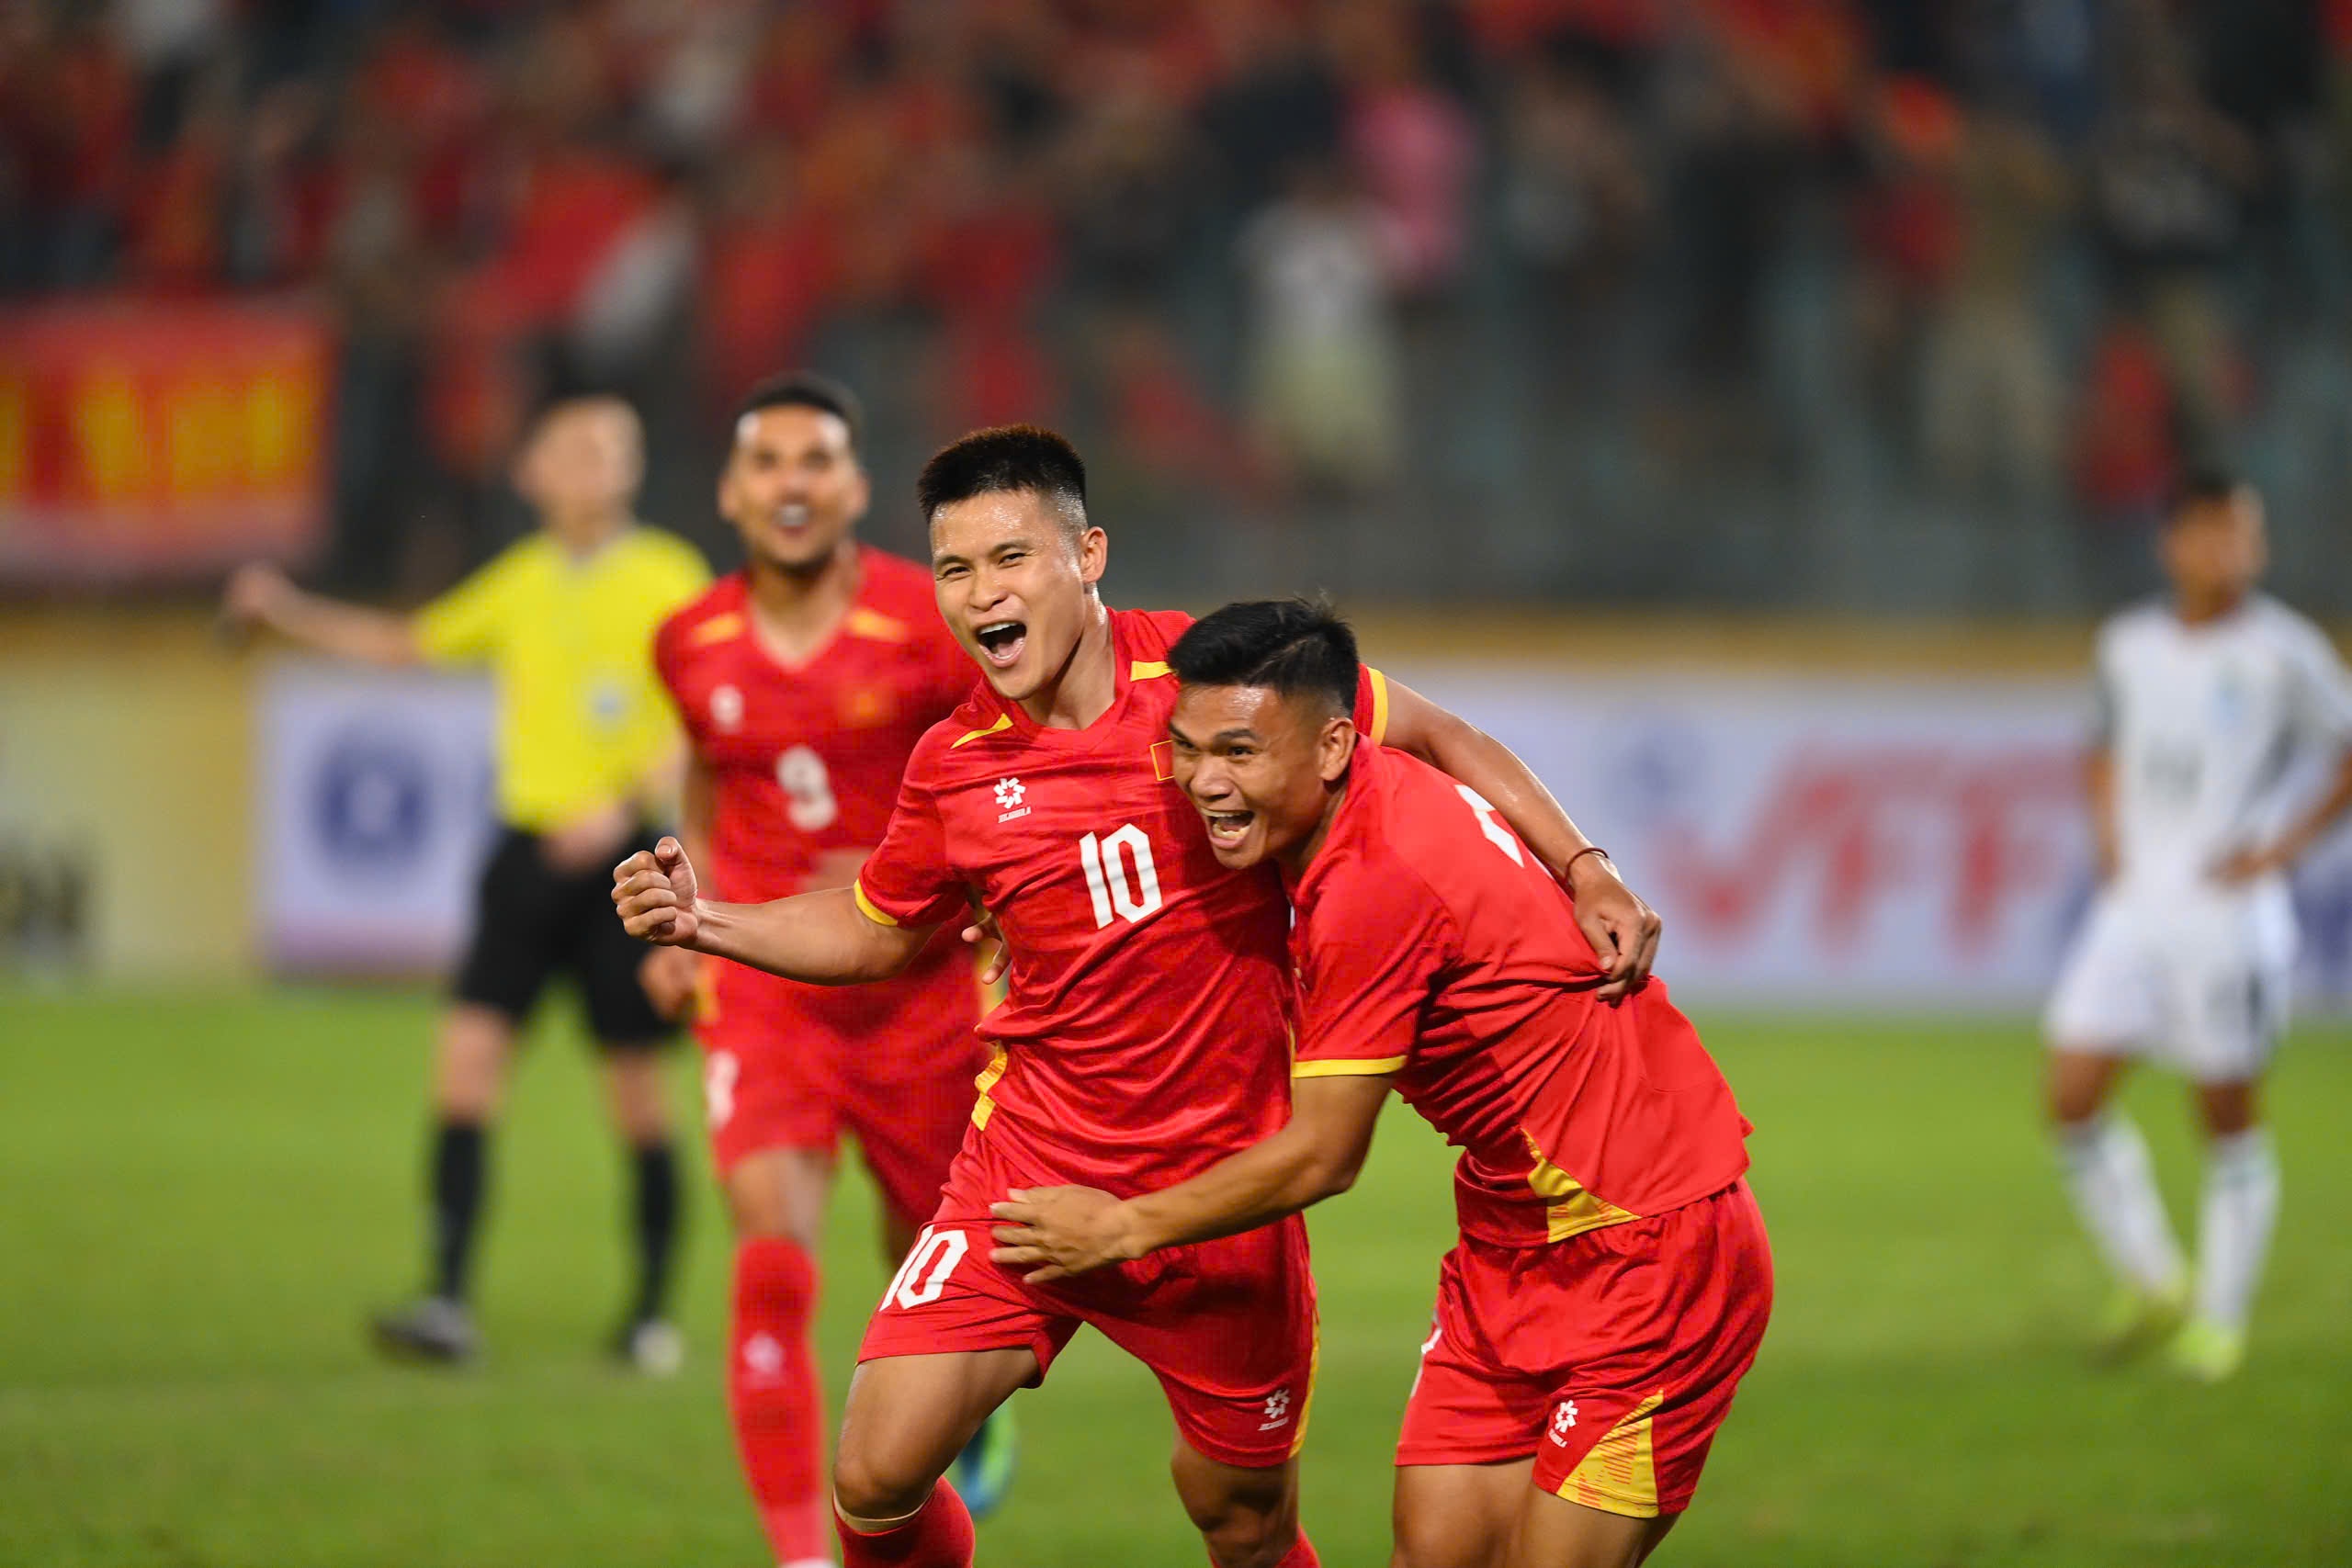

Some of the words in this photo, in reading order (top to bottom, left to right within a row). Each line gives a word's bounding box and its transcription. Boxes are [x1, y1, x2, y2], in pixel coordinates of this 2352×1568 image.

[776, 745, 837, 831] 9
[1079, 823, 1163, 930] 10
[879, 1224, 969, 1312] 10
